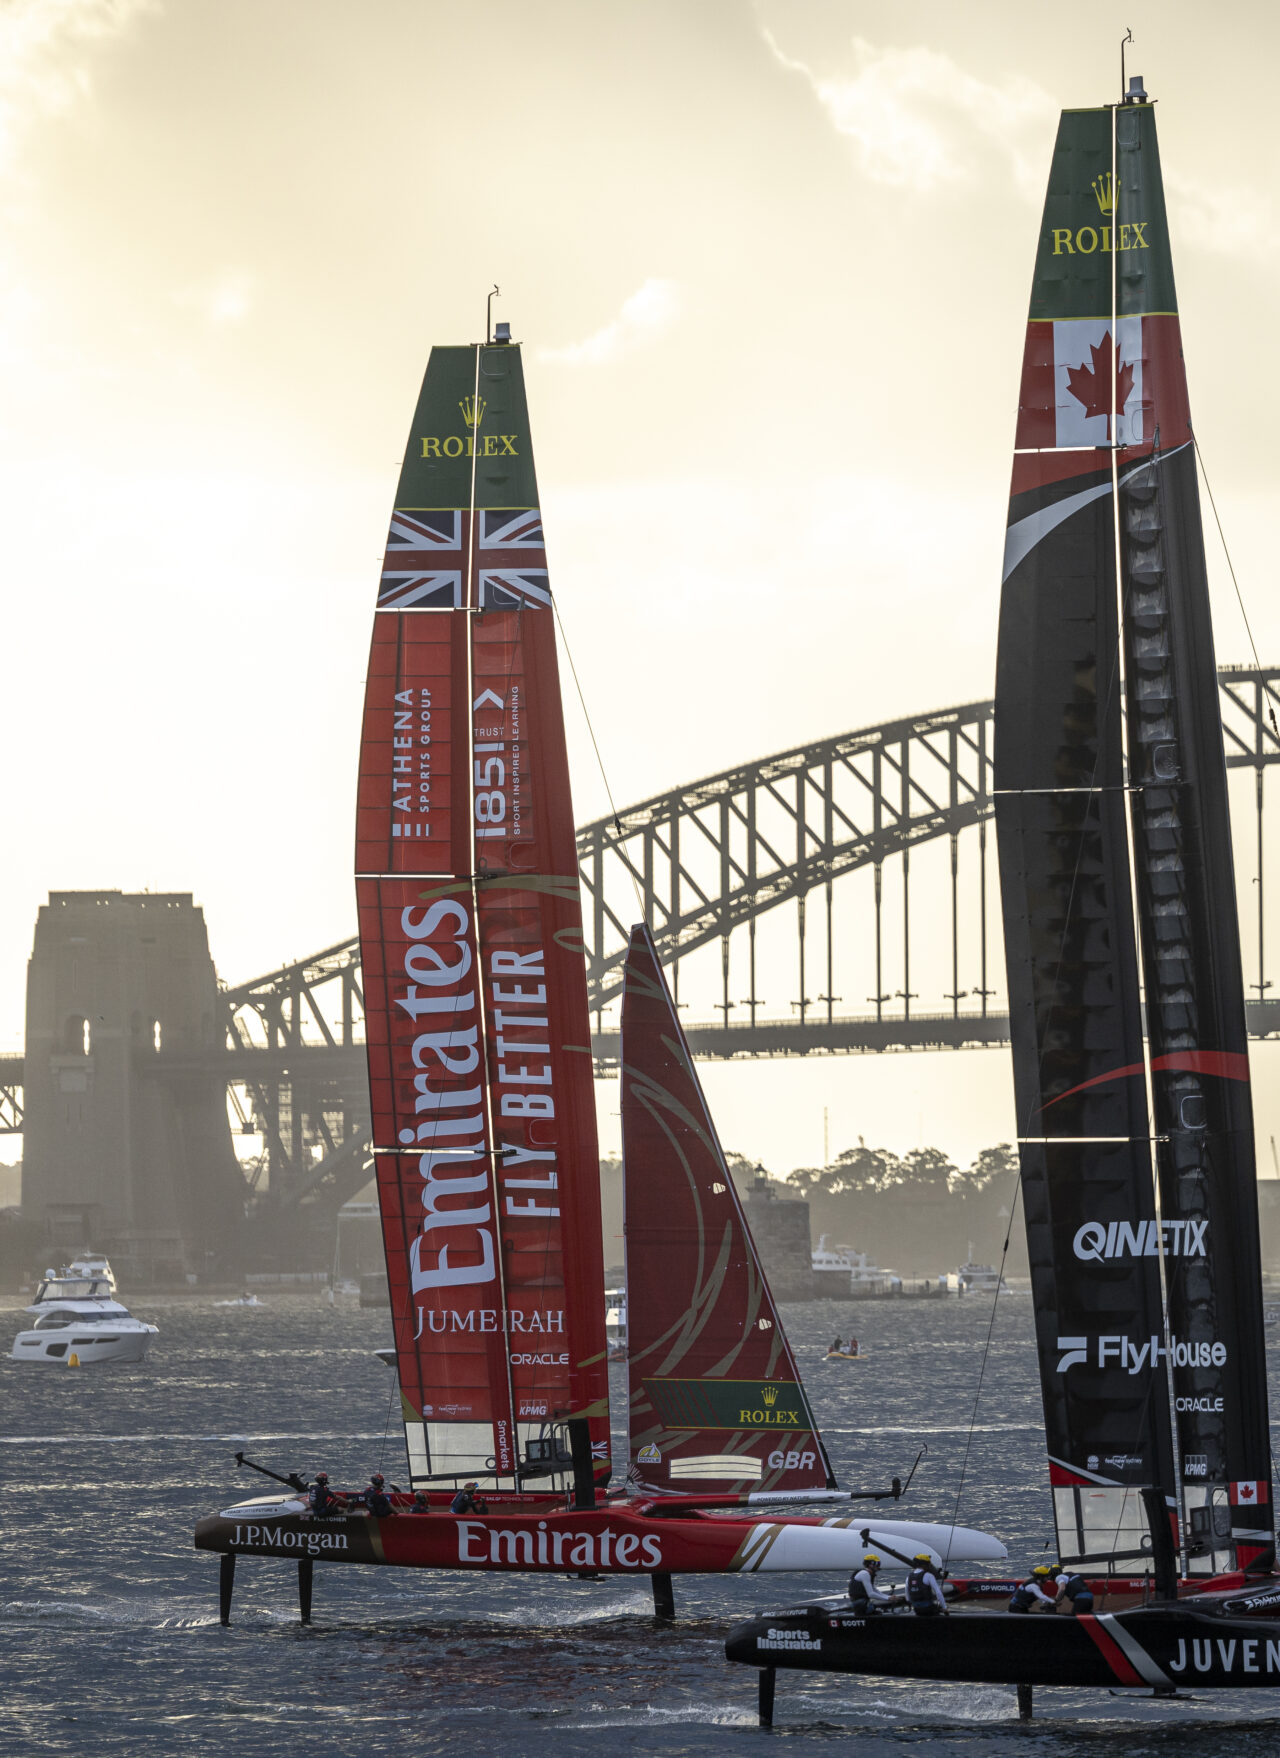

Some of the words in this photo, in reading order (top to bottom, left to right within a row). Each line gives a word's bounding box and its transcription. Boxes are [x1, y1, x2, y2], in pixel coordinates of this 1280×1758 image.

[1052, 222, 1149, 255] ROLEX
[420, 435, 519, 458] ROLEX
[421, 688, 431, 744] GROUP
[474, 727, 505, 736] TRUST
[511, 686, 519, 741] LEARNING
[393, 688, 413, 812] ATHENA
[420, 752, 431, 813] SPORTS
[512, 744, 520, 795] INSPIRED
[473, 742, 506, 838] 1851
[513, 799, 521, 835] SPORT
[491, 949, 555, 1119] BETTER
[394, 899, 496, 1296] Emirates
[502, 1143, 561, 1217] FLY
[1073, 1220, 1208, 1263] QINETIX
[413, 1306, 564, 1340] JUMEIRAH
[510, 1353, 569, 1365] ORACLE
[1098, 1335, 1227, 1374] FlyHouse
[519, 1405, 547, 1416] KPMG
[739, 1410, 799, 1424] ROLEX
[1176, 1398, 1224, 1411] ORACLE
[497, 1420, 509, 1469] Smarkets
[767, 1451, 816, 1470] GBR
[1184, 1463, 1206, 1475] KPMG
[229, 1525, 349, 1555] J.P.Morgan
[456, 1520, 662, 1567] Emirates
[757, 1637, 822, 1650] Illustrated
[767, 1629, 810, 1640] Sports
